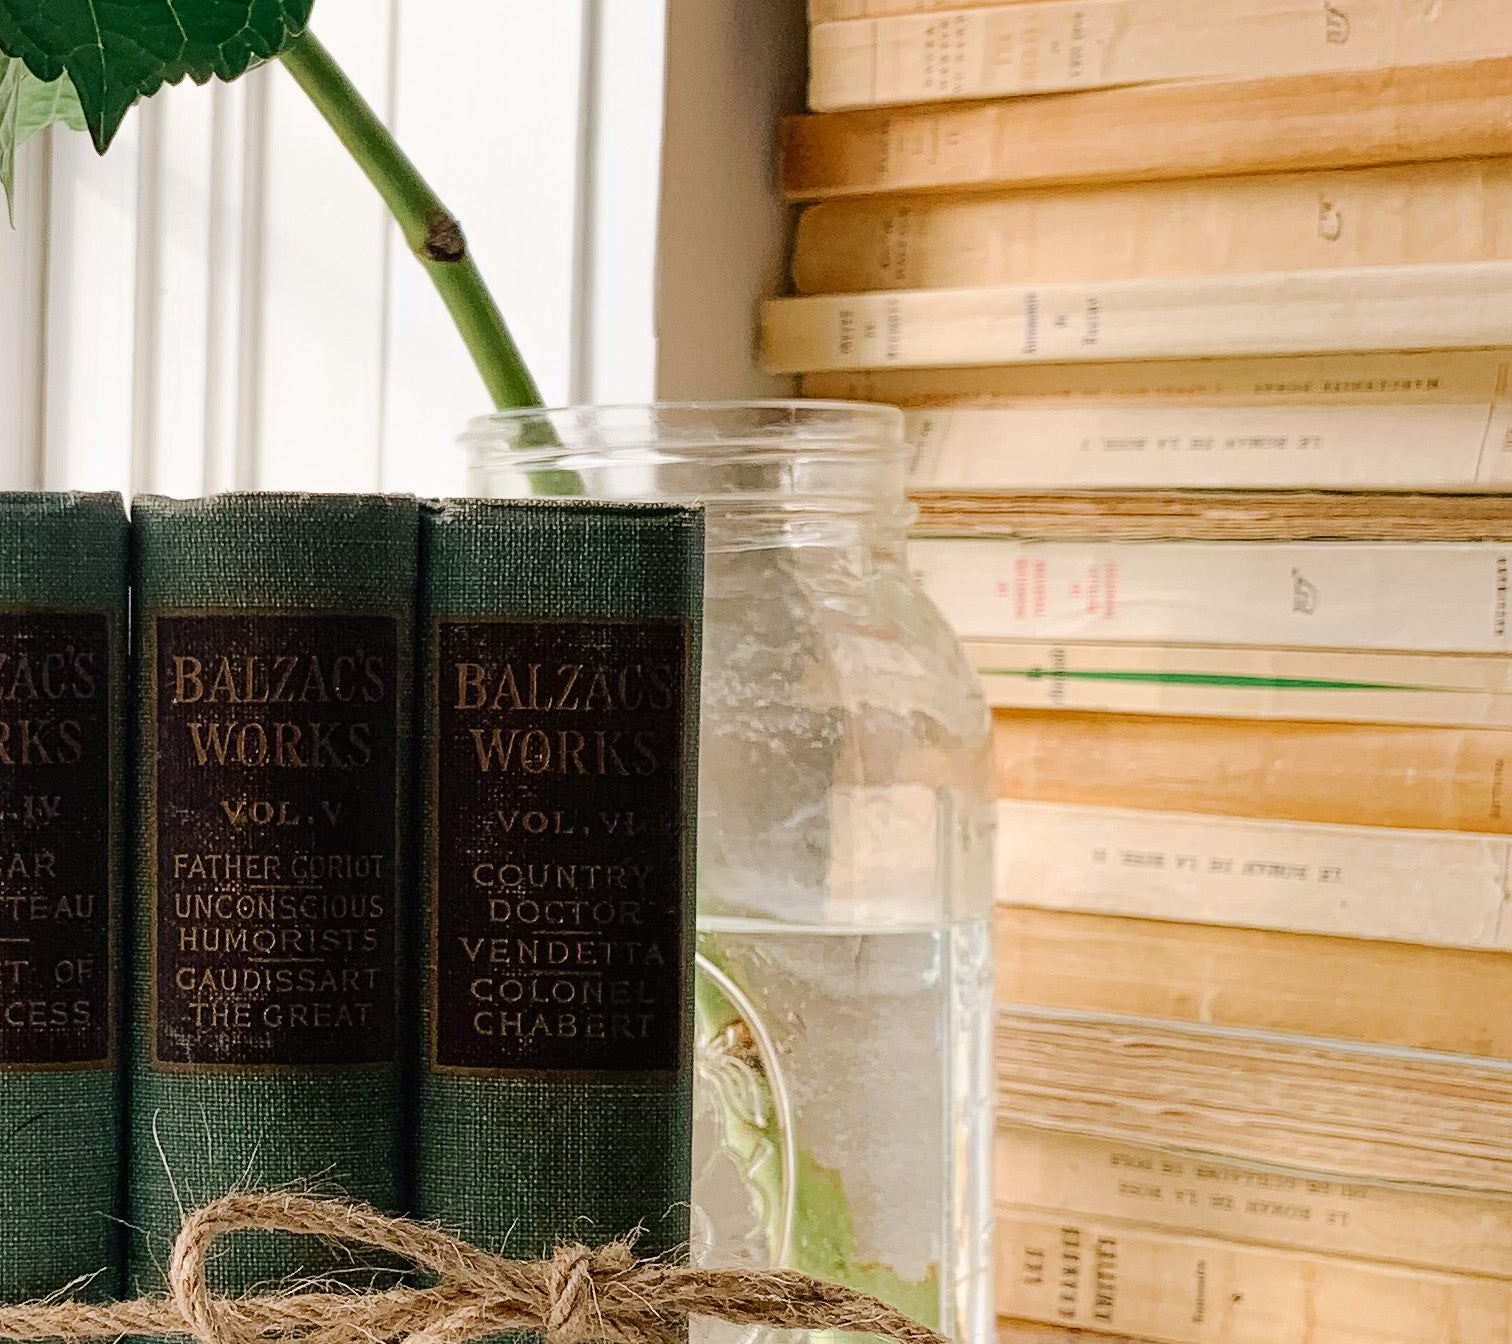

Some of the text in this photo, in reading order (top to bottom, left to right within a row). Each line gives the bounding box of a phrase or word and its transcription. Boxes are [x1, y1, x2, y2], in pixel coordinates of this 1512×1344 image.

[172, 647, 386, 705] BALZAC'S
[453, 655, 674, 712] BALZAC'S
[187, 720, 373, 769] WORKS
[469, 728, 659, 778] WORKS
[173, 853, 385, 881] FATHER GORIOT
[472, 863, 654, 891] COUNTRY
[174, 893, 385, 922] UNCONSCIOUS
[489, 899, 645, 927] DOCTOR
[178, 926, 380, 955] HUMORISTS
[458, 936, 667, 967] VENDETTA
[54, 957, 95, 985] OF
[175, 966, 381, 995] GAUDISSART
[470, 977, 658, 1005] COLONEL
[189, 1002, 375, 1030] THE GREAT
[473, 1011, 655, 1040] CHABERT
